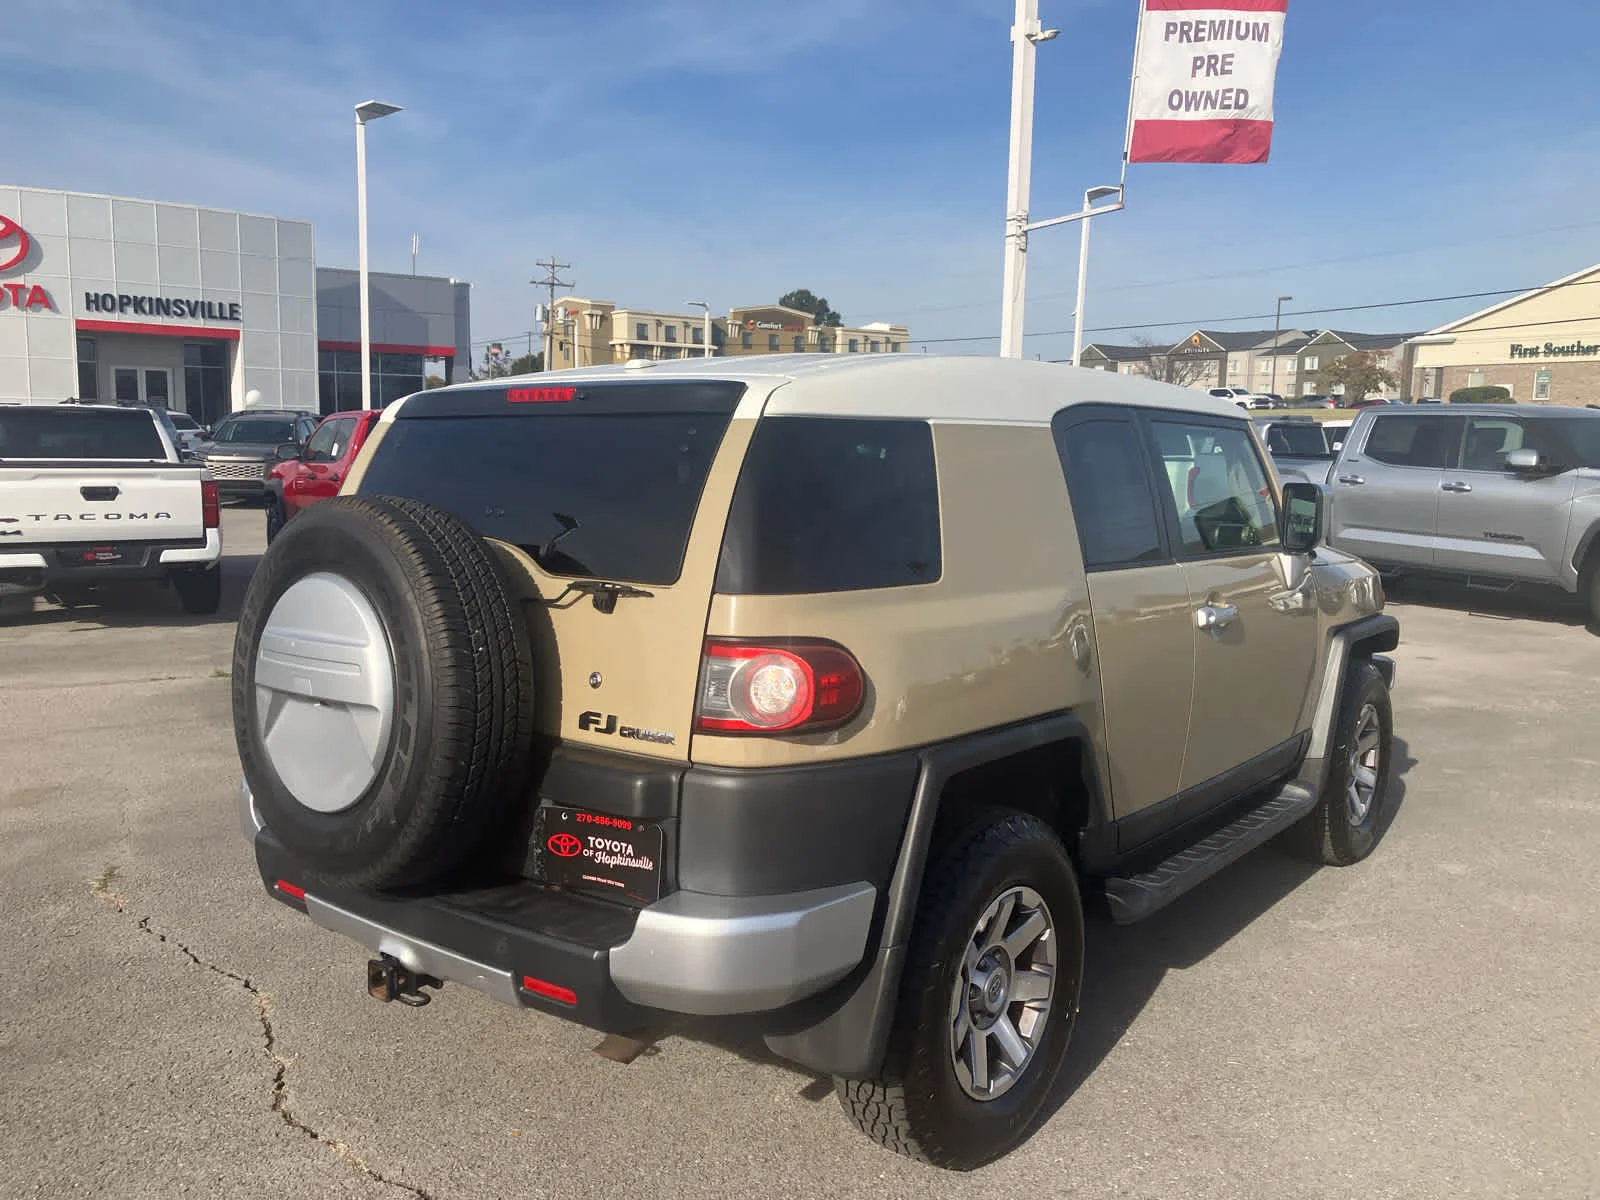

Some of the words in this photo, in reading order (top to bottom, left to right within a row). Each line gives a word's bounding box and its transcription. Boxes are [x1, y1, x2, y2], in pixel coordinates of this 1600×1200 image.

[1164, 19, 1270, 43] PREMIUM
[1191, 53, 1235, 78] PRE
[1167, 88, 1249, 112] OWNED
[0, 283, 51, 309] TA
[84, 292, 242, 321] HOPKINSVILLE
[1510, 343, 1540, 357] First
[26, 512, 172, 521] TACOMA
[578, 710, 618, 735] FJ
[587, 836, 634, 857] TOYOTA
[594, 850, 654, 871] Hopkinsville
